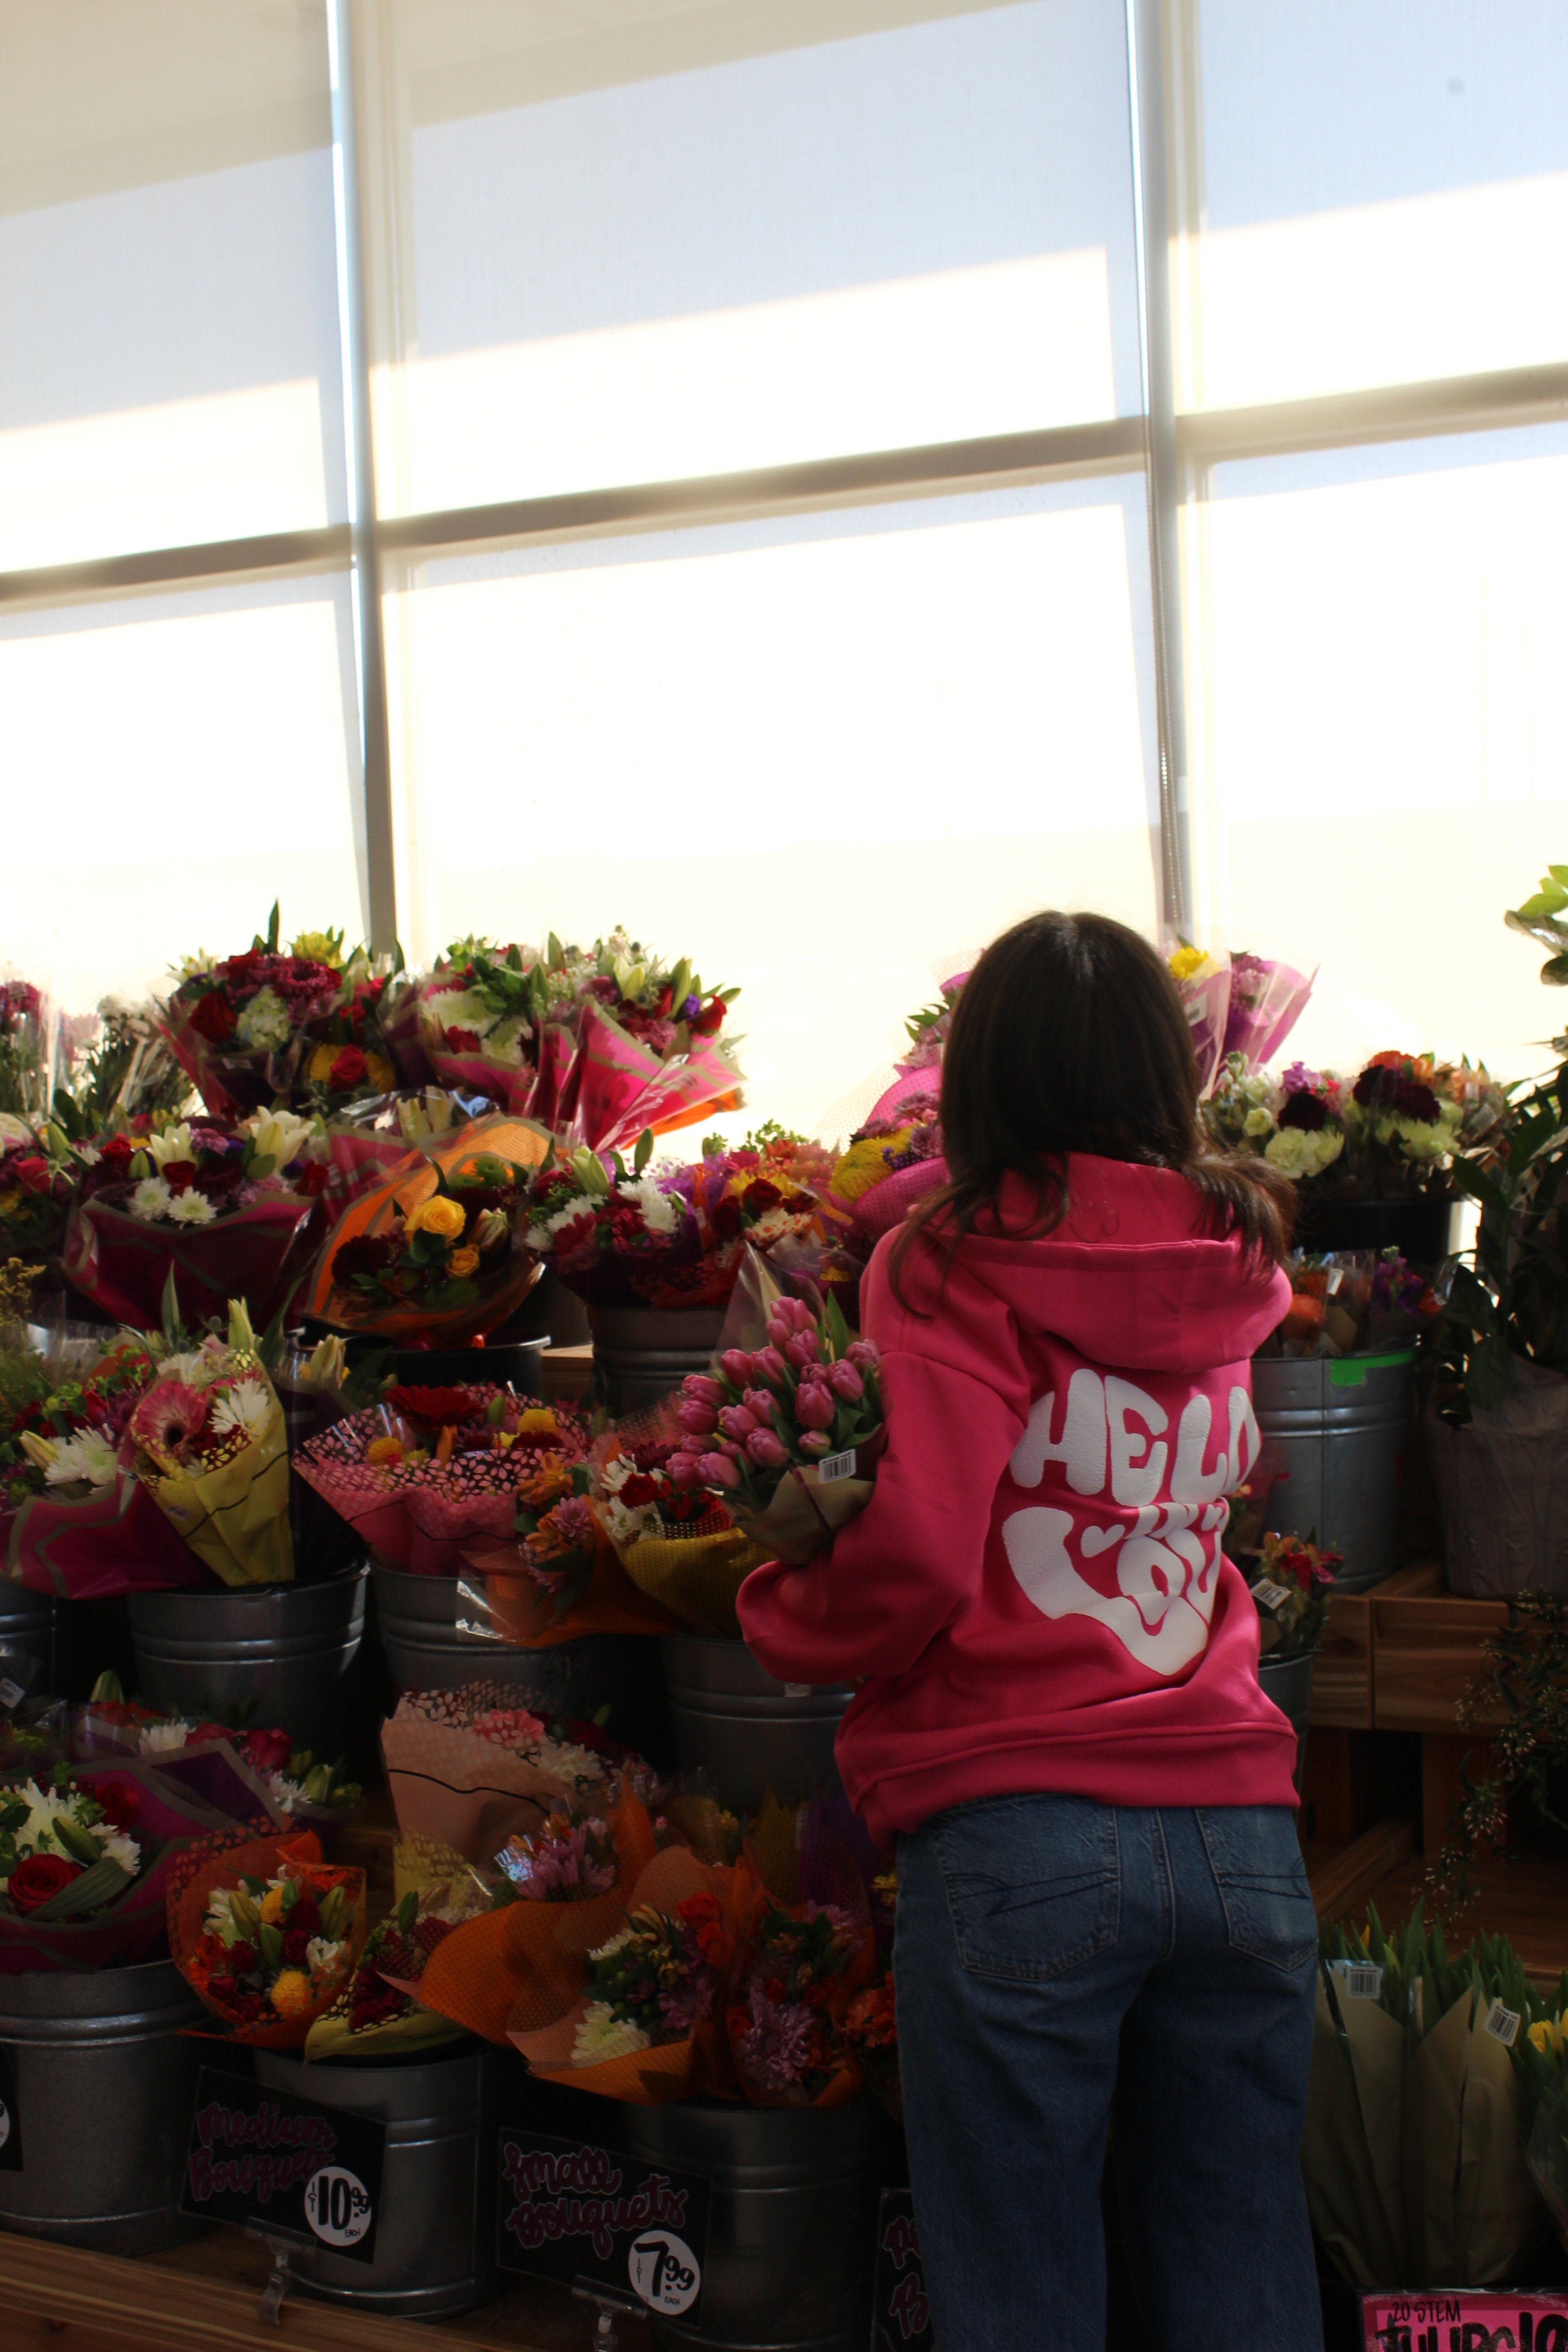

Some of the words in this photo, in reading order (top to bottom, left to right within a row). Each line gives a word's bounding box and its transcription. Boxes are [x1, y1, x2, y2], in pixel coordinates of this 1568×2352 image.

[196, 2102, 338, 2151] Medium
[1392, 2302, 1411, 2322] 20
[1414, 2300, 1461, 2323] STEM
